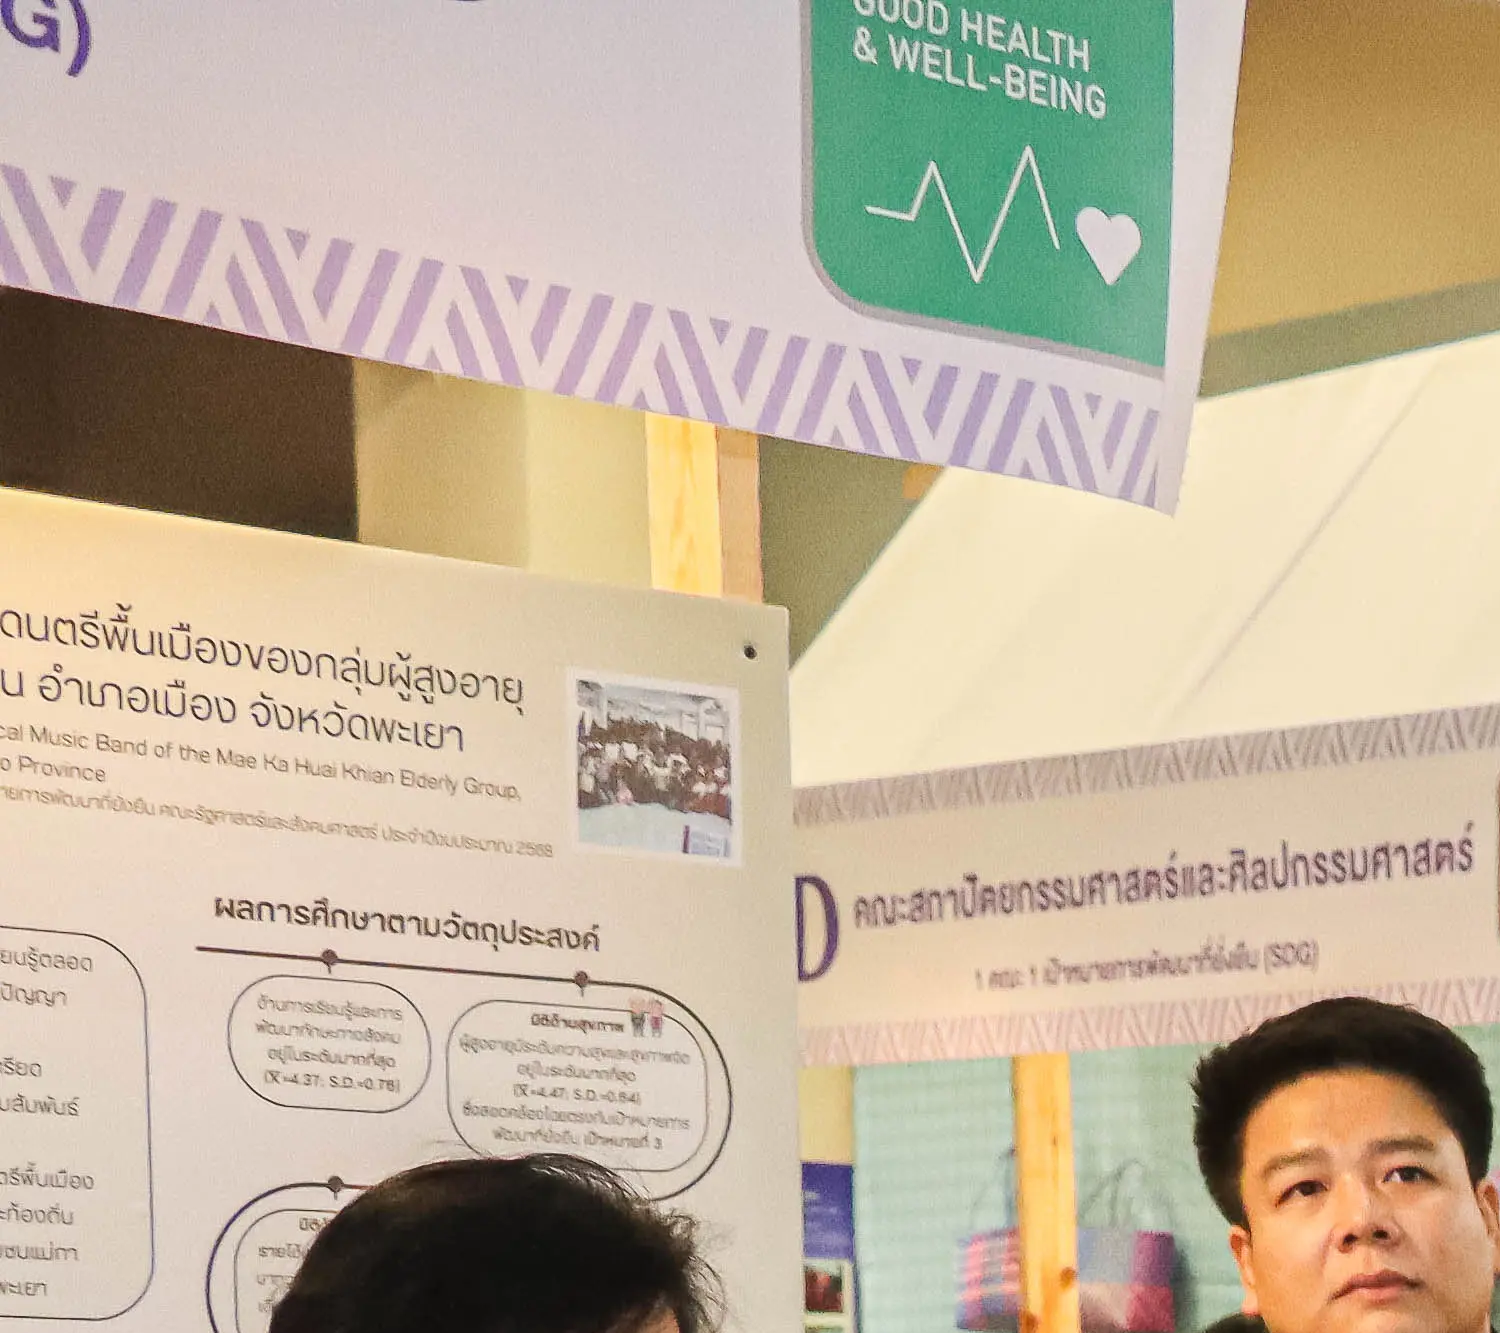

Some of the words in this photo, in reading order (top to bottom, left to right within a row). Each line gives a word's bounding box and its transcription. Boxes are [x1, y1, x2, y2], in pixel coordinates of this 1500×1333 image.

[852, 25, 879, 66] &
[887, 32, 1108, 120] WELL-BEING
[960, 8, 1091, 73] HEALTH
[38, 662, 237, 724] อำเภอเมือง
[250, 691, 464, 751] จังหวัดพะเยา
[18, 755, 107, 784] Province
[29, 725, 89, 749] Music
[96, 733, 148, 757] Band
[154, 742, 174, 759] of
[180, 744, 211, 764] the
[217, 748, 257, 769] Mae
[264, 752, 289, 773] Ka
[295, 757, 338, 779] Huai
[342, 763, 394, 785] Khian
[400, 769, 458, 797] Elderly
[214, 896, 601, 952] ผลการศึกษาตามวัตถุประสงค์
